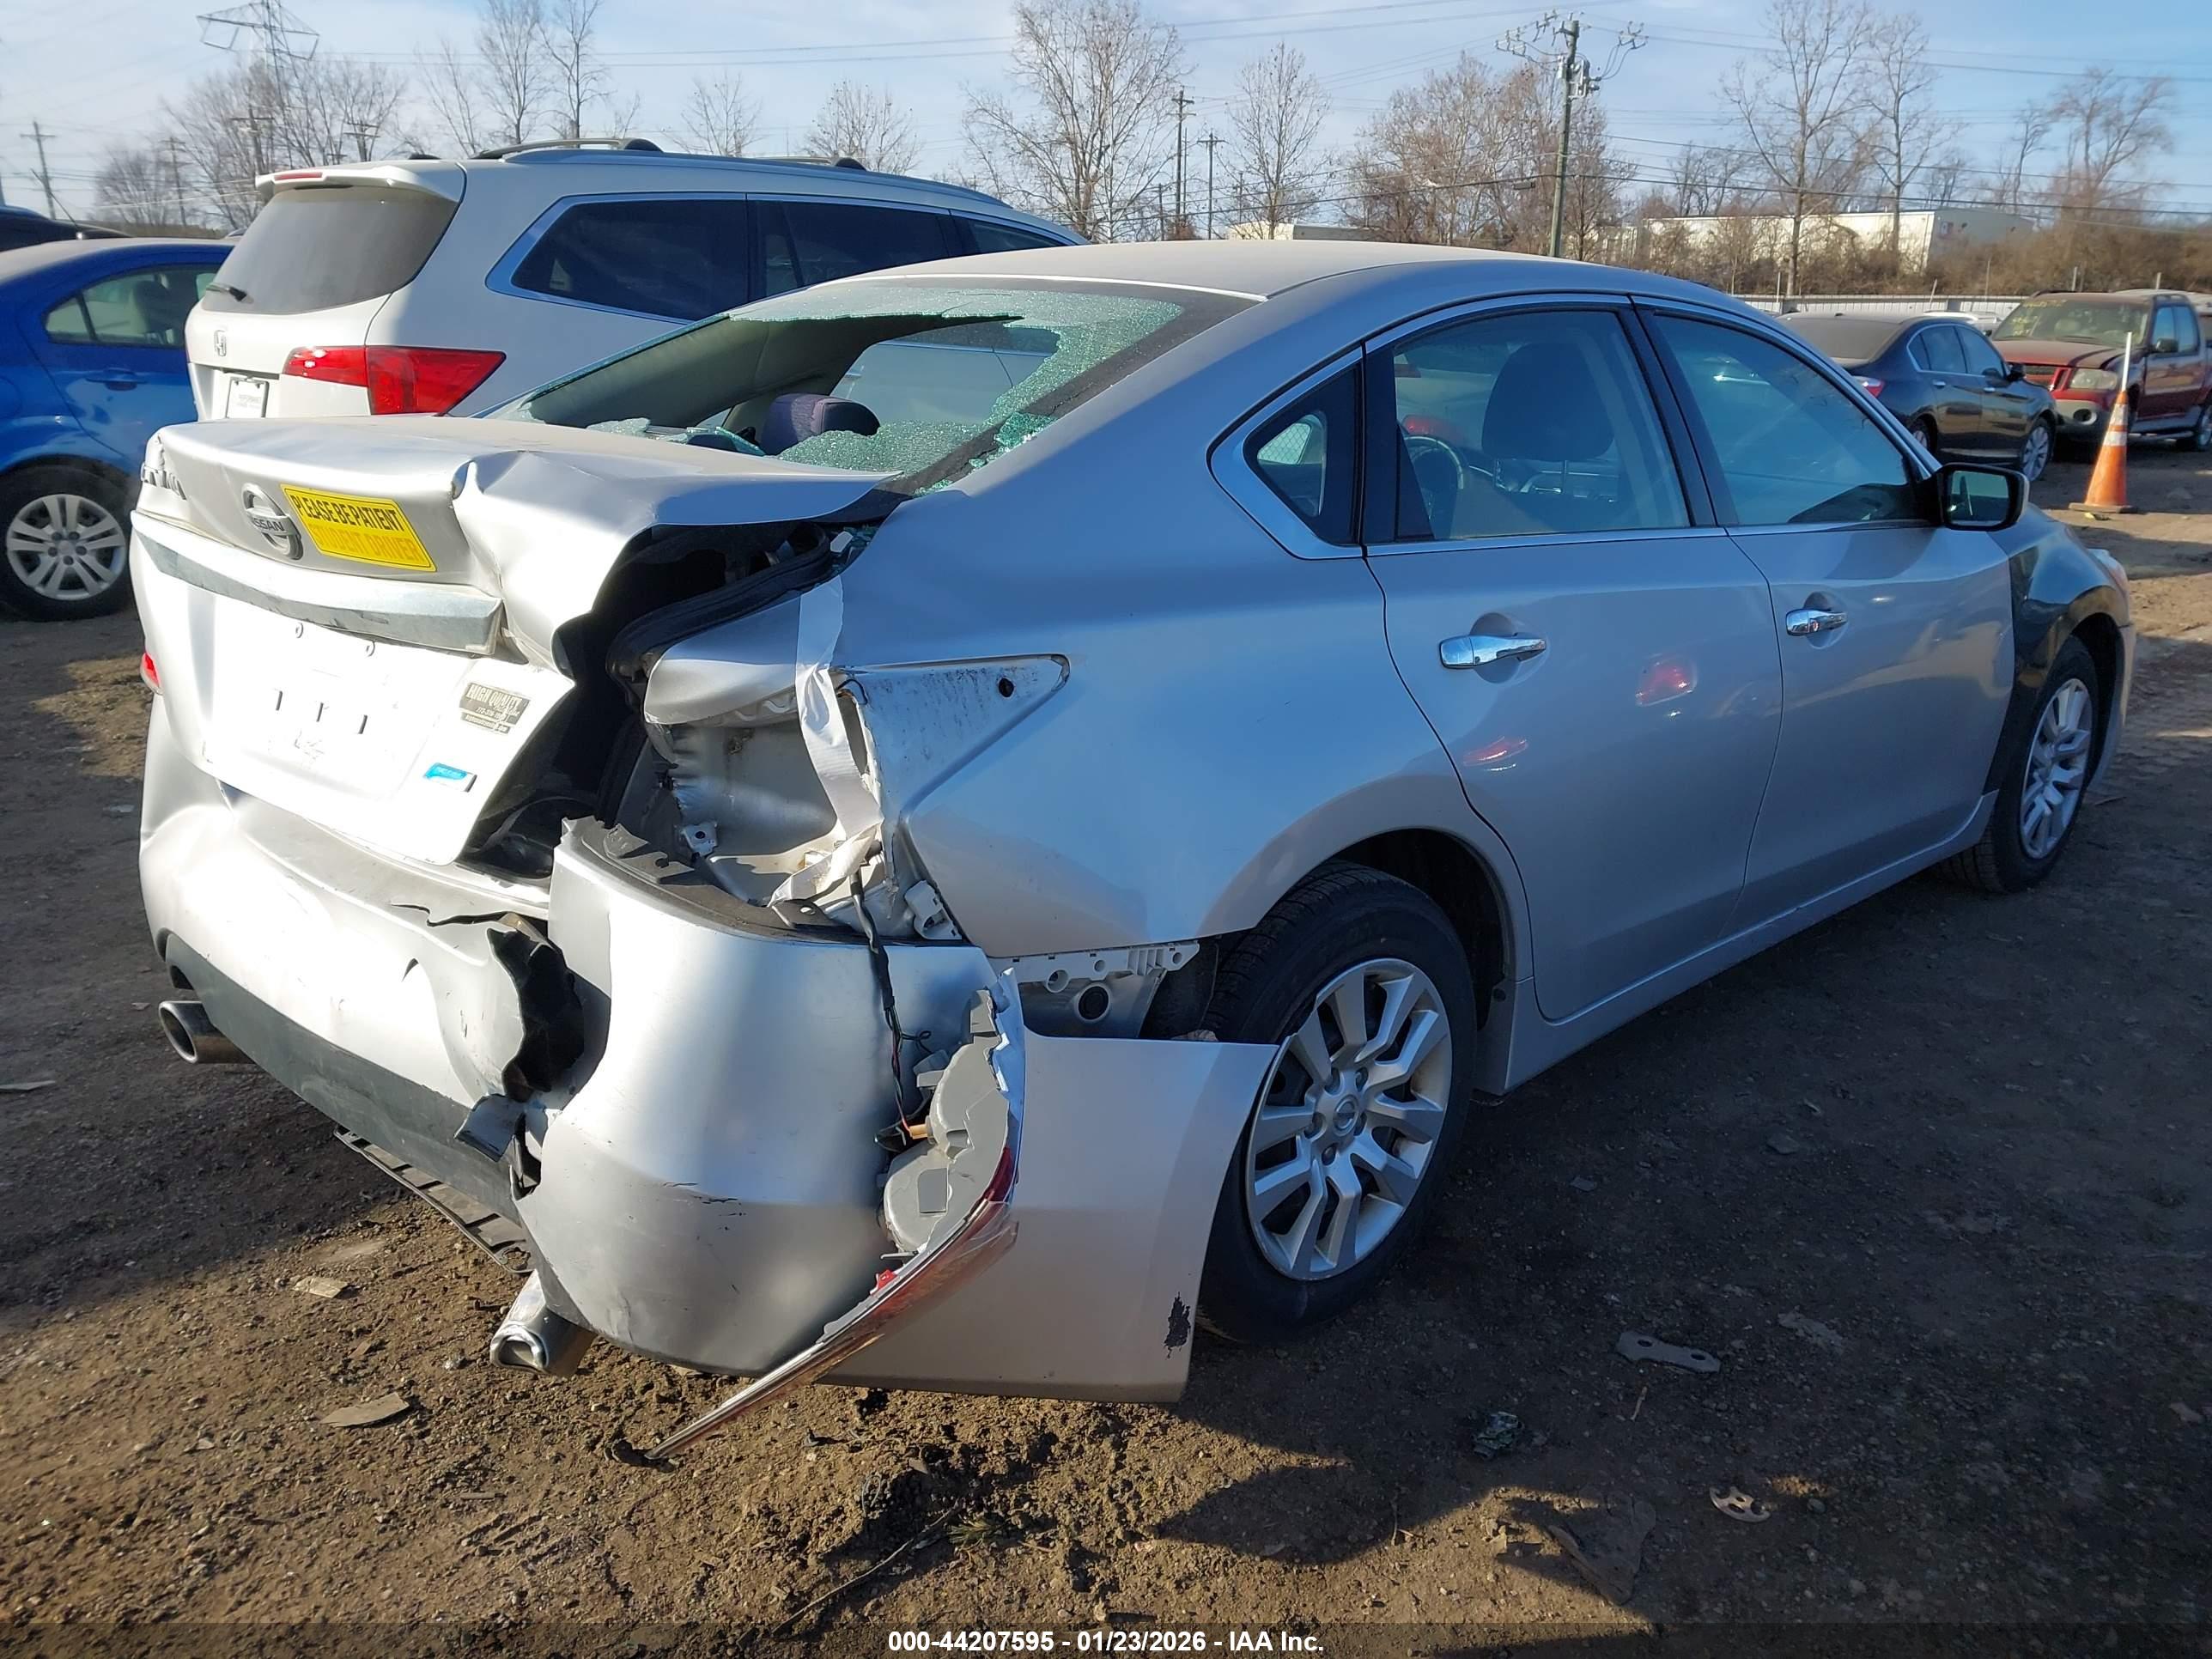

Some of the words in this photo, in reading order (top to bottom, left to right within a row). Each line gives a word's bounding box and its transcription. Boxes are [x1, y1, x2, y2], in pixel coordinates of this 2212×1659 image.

[252, 517, 285, 532] SSAN
[289, 495, 339, 523] PLEASE
[331, 502, 356, 526] BE
[349, 505, 405, 532] PATIENT
[307, 523, 366, 554] STUDENT
[364, 532, 425, 562] DRIVER
[465, 684, 491, 702] HIGH
